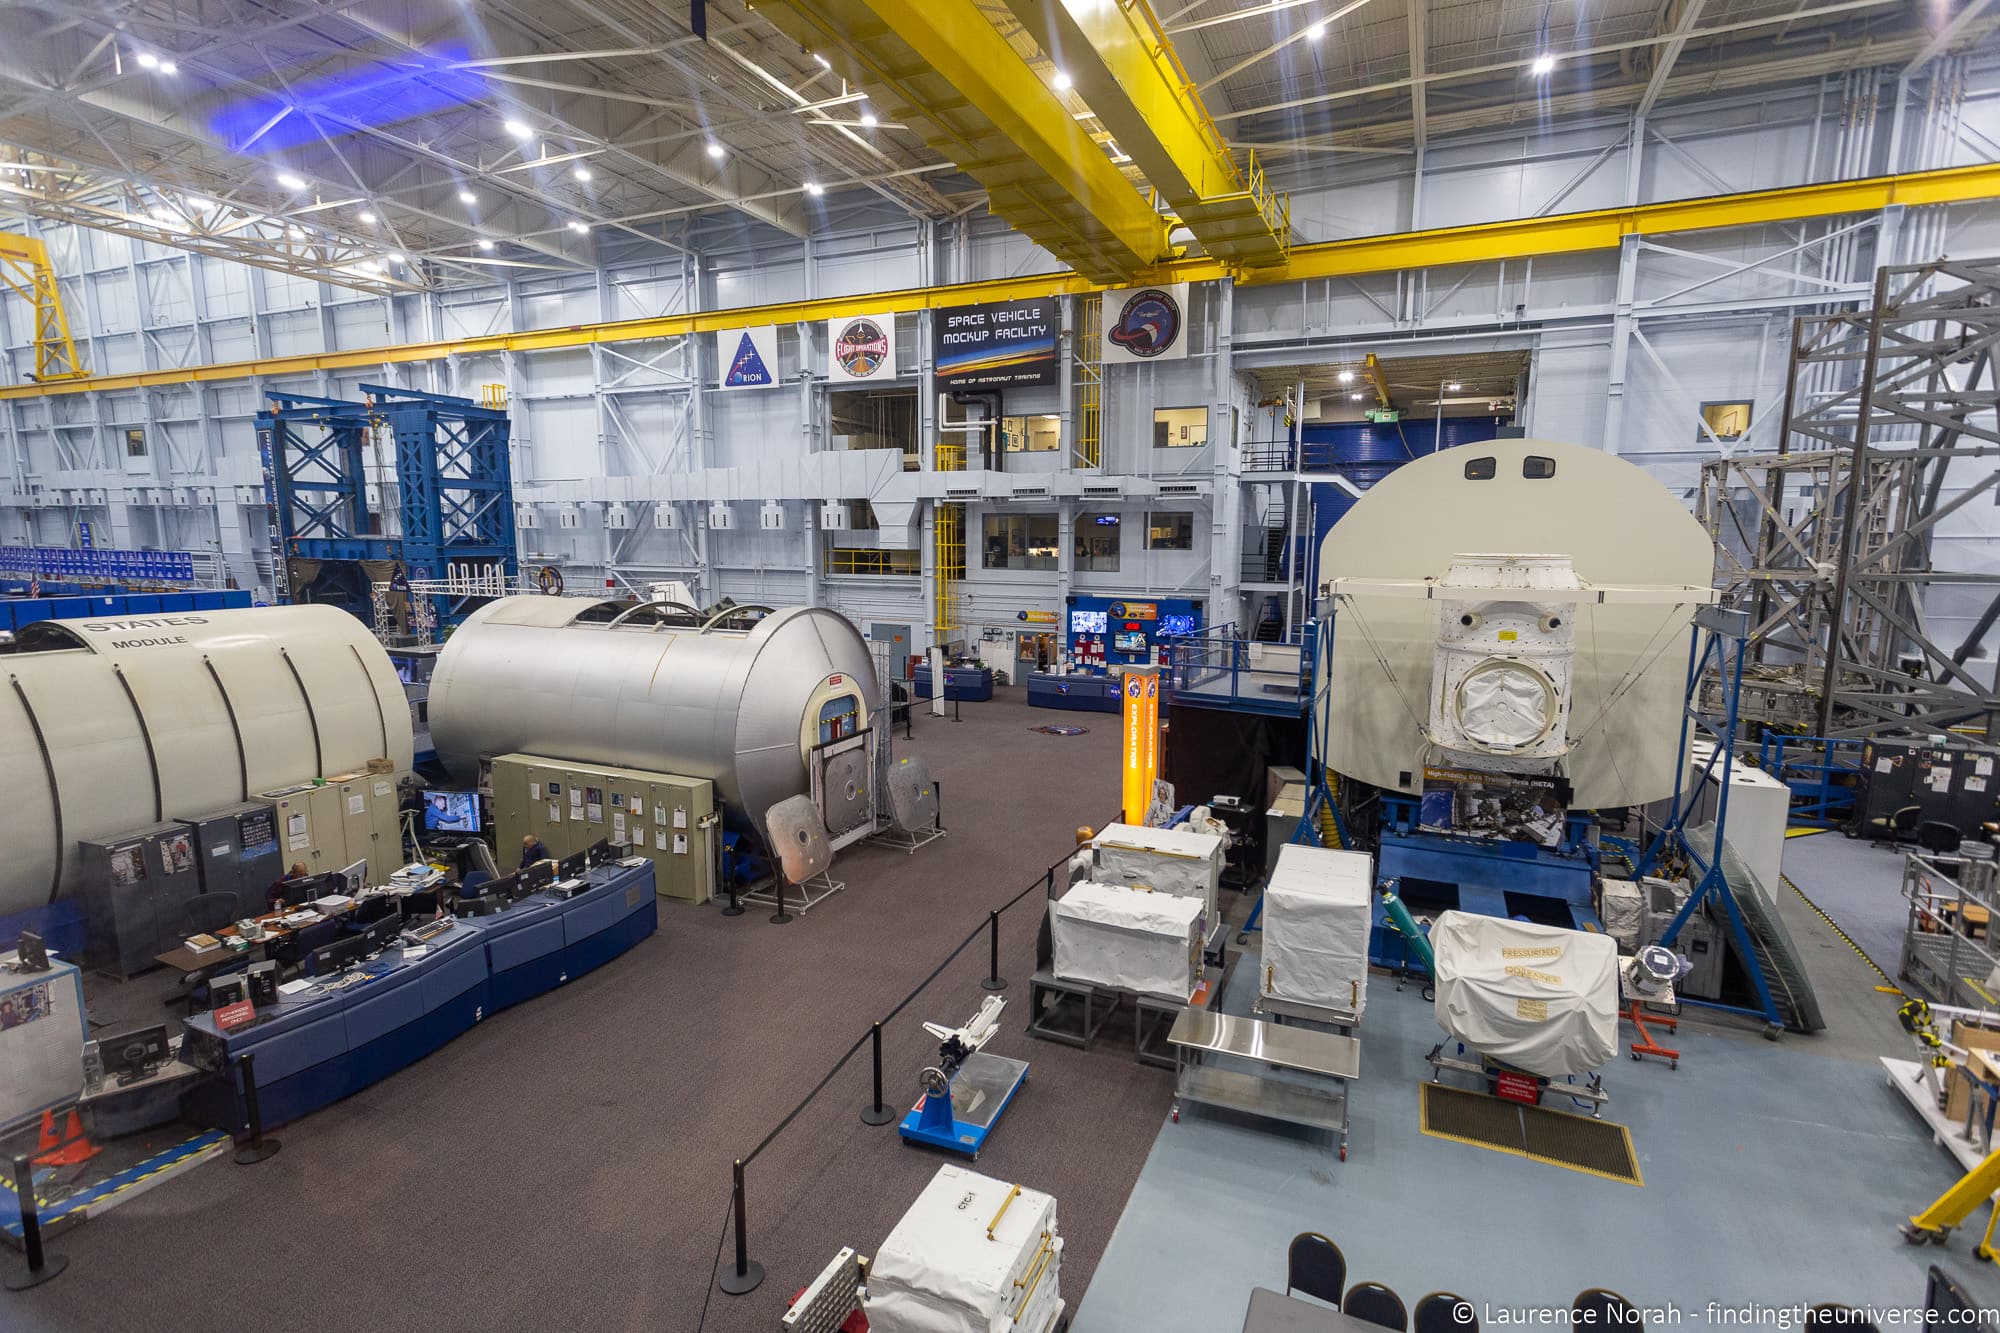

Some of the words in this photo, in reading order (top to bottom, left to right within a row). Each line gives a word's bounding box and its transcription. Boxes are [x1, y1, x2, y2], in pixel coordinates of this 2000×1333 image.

[948, 314, 985, 328] SPACE
[991, 308, 1041, 323] VEHICLE
[943, 330, 989, 345] MOCKUP
[995, 325, 1047, 340] FACILITY
[978, 375, 1012, 383] ASTRONAUT
[1014, 373, 1041, 381] TRAINING
[447, 562, 506, 598] ORION
[83, 616, 209, 632] STATES
[112, 635, 189, 649] MODULE
[1129, 703, 1139, 769] EXPLORATION
